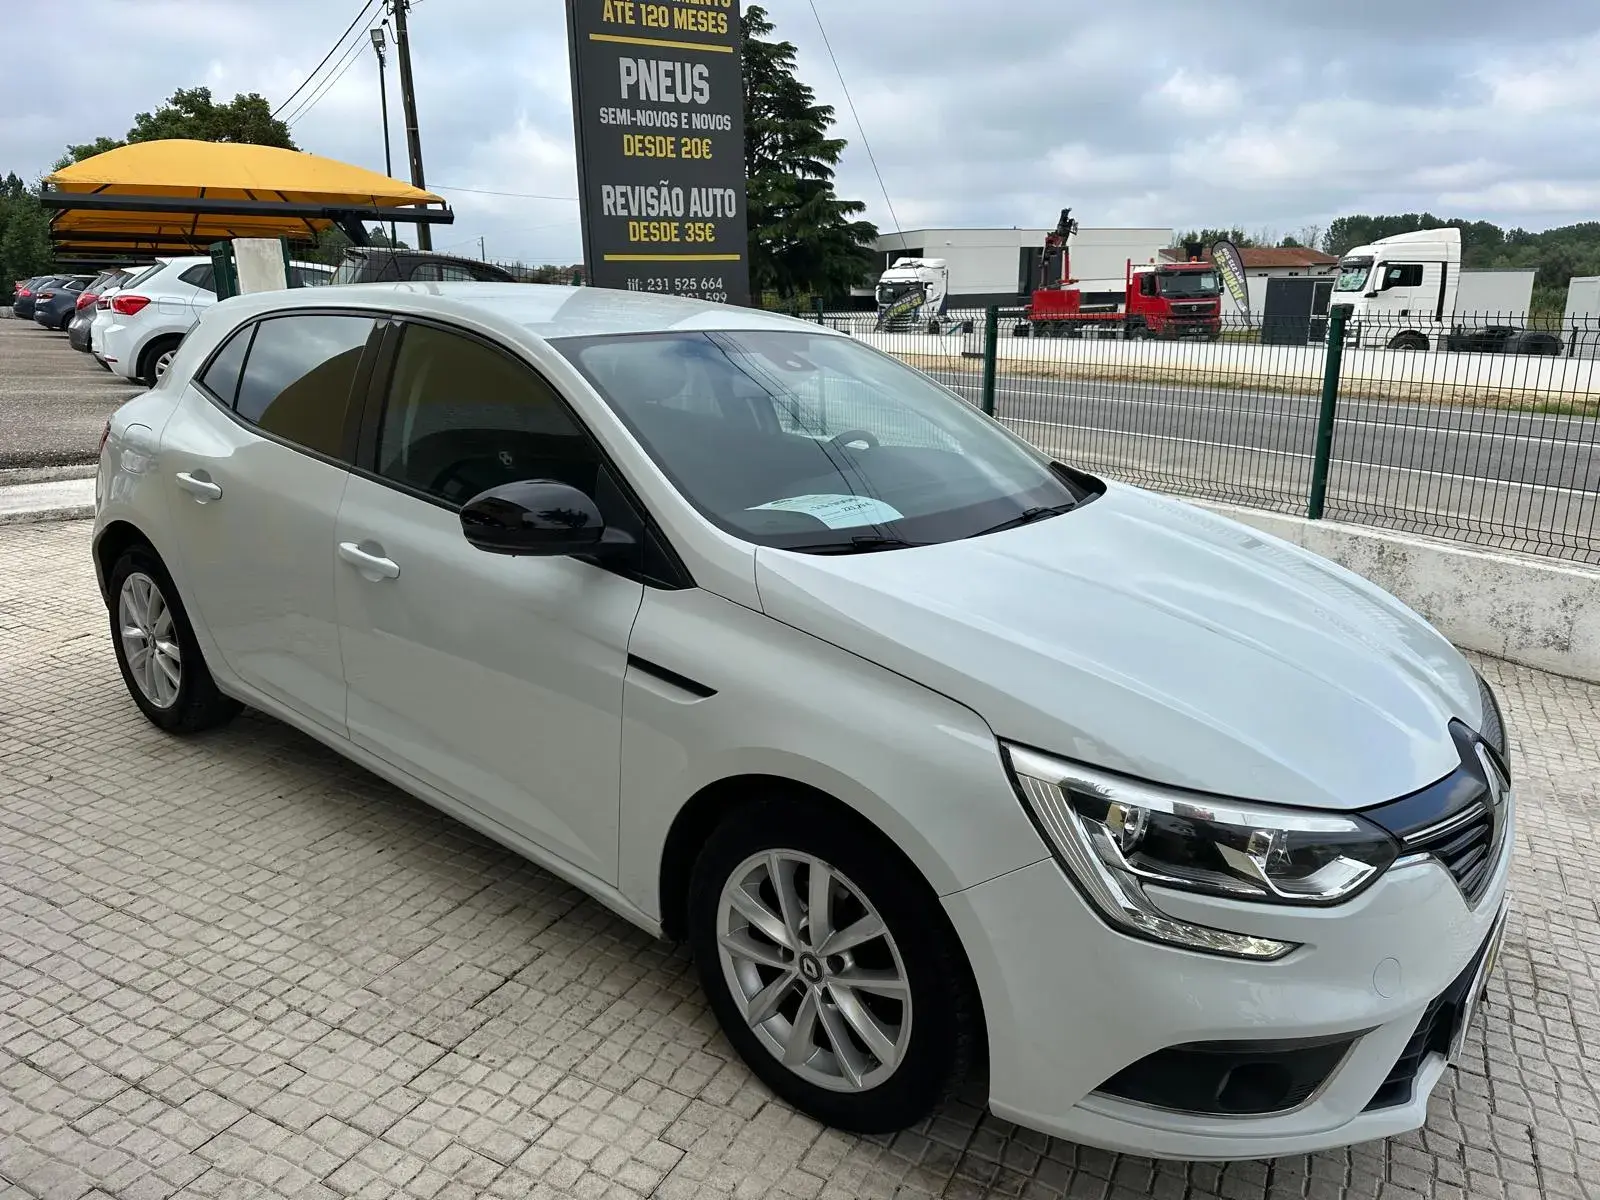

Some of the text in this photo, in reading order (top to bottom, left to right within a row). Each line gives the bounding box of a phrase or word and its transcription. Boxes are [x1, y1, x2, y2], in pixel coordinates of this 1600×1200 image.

[602, 0, 728, 34] ATÉ 120 MESES
[619, 56, 710, 105] PNEUS
[600, 107, 732, 131] SEMI-NOVOS E NOVOS
[623, 134, 713, 160] DESDE 20€
[601, 180, 737, 218] REVISÃO AUTO
[629, 221, 716, 243] DESDE 35€
[647, 278, 669, 291] 231
[674, 278, 697, 291] 525
[701, 277, 723, 290] 664
